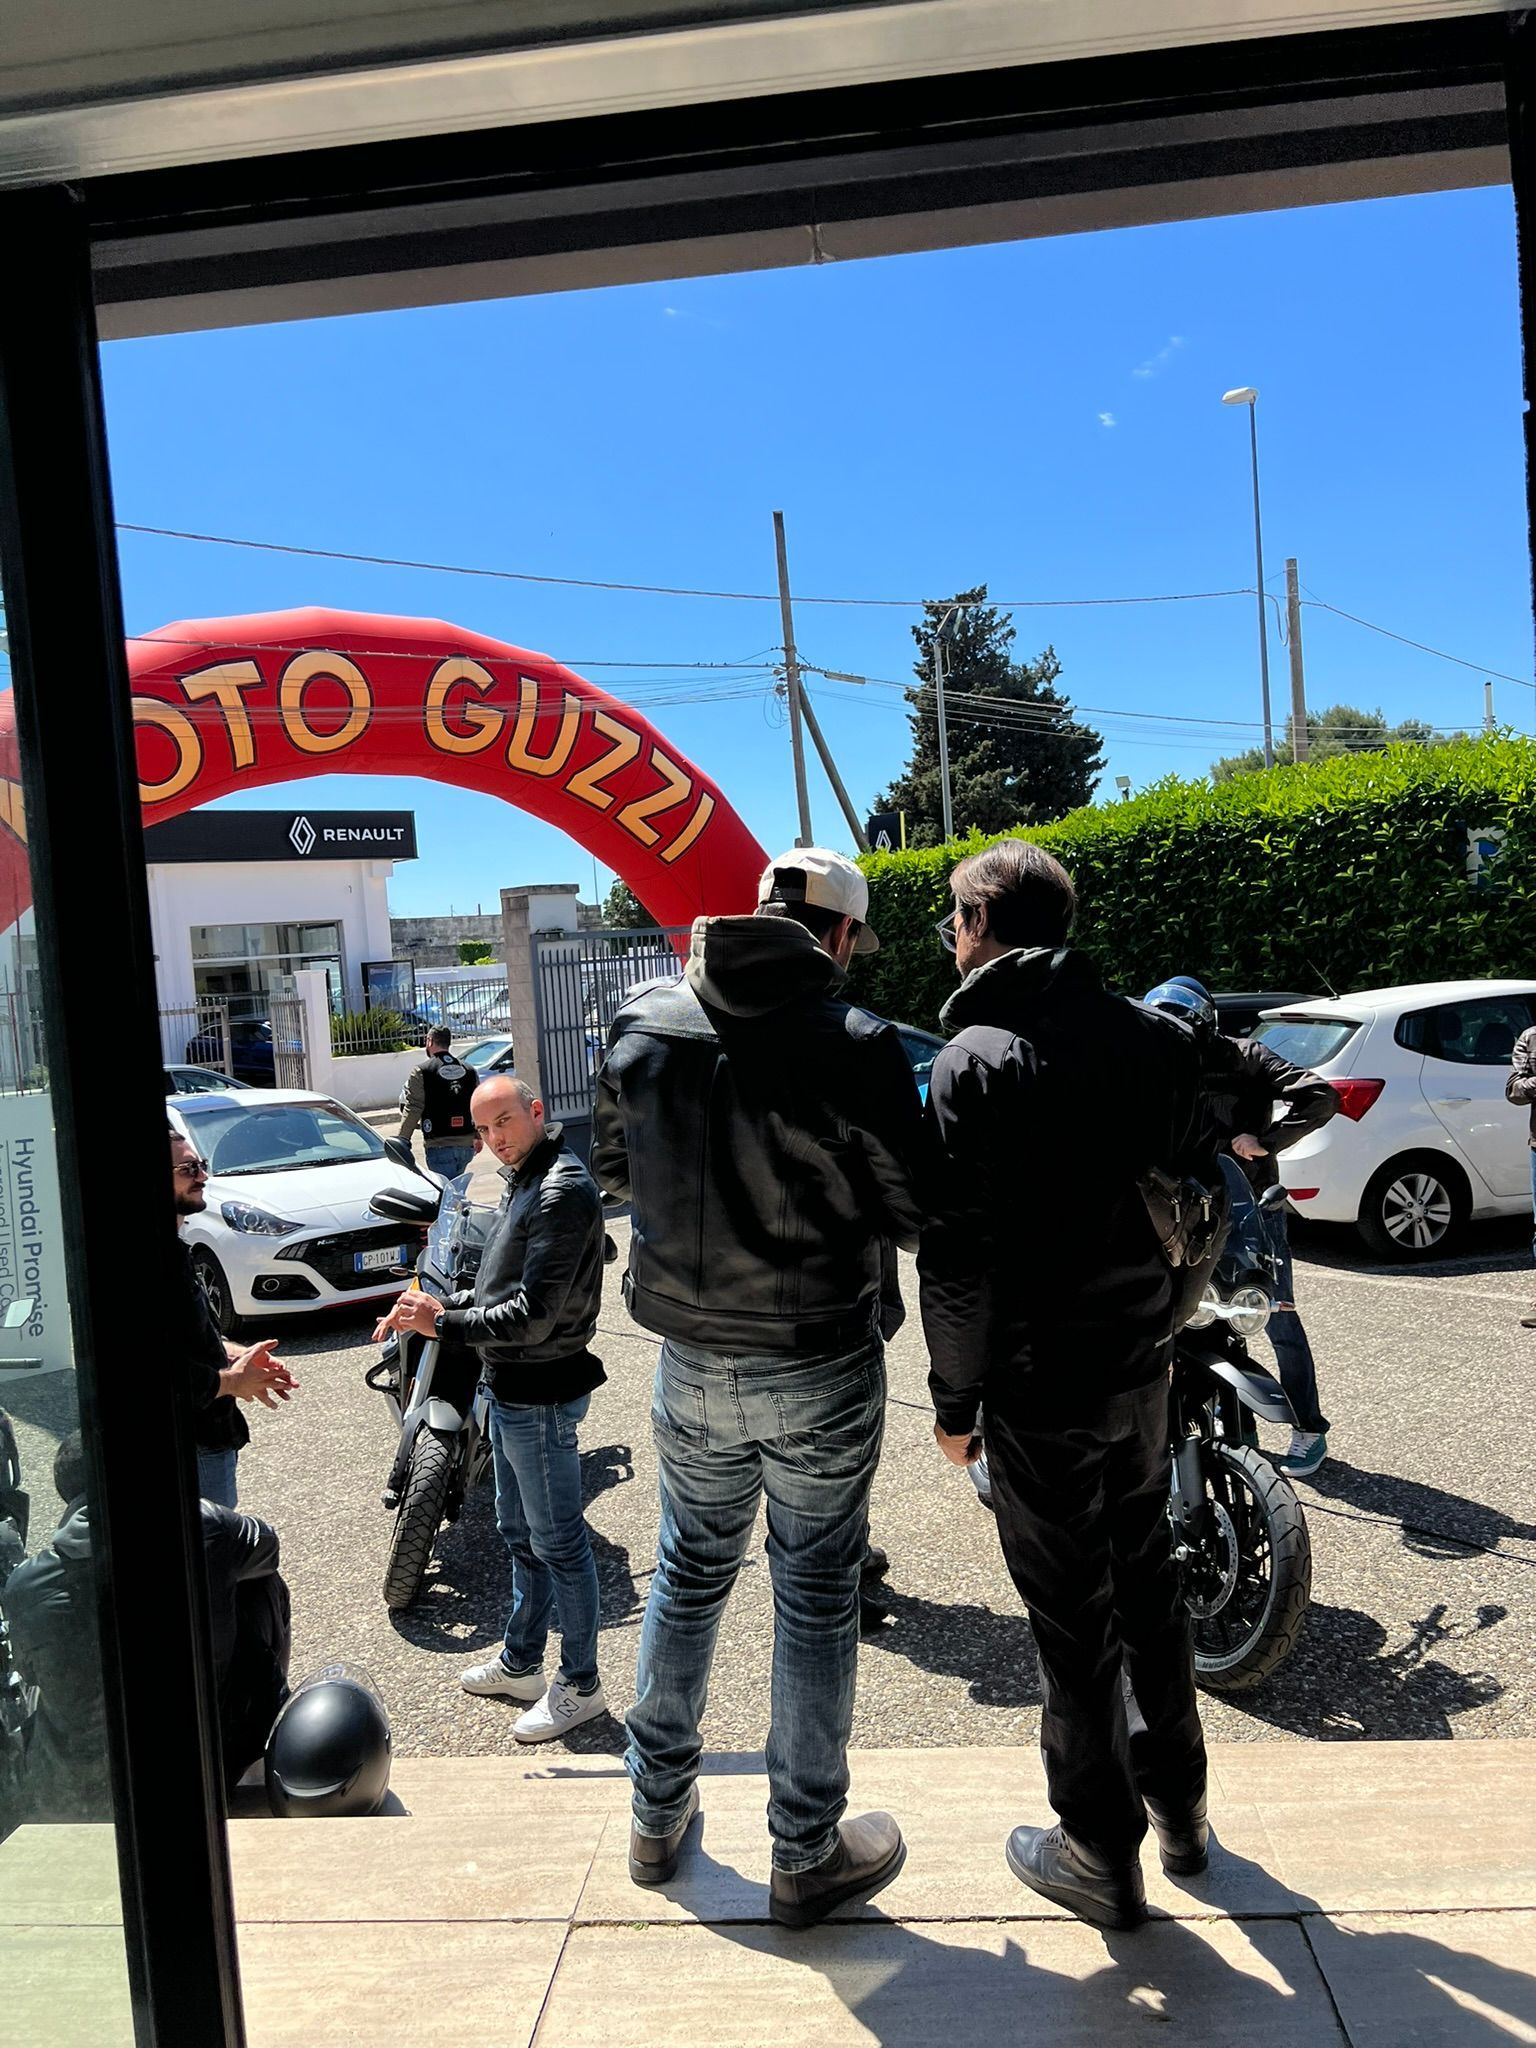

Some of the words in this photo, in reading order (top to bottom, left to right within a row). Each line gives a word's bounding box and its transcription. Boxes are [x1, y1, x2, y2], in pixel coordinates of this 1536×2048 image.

[131, 650, 374, 804] OTO
[423, 655, 716, 865] GUZZI
[323, 828, 404, 841] RENAULT
[11, 1138, 43, 1237] Hyundai
[23, 1242, 48, 1337] Promise
[556, 1698, 579, 1718] N
